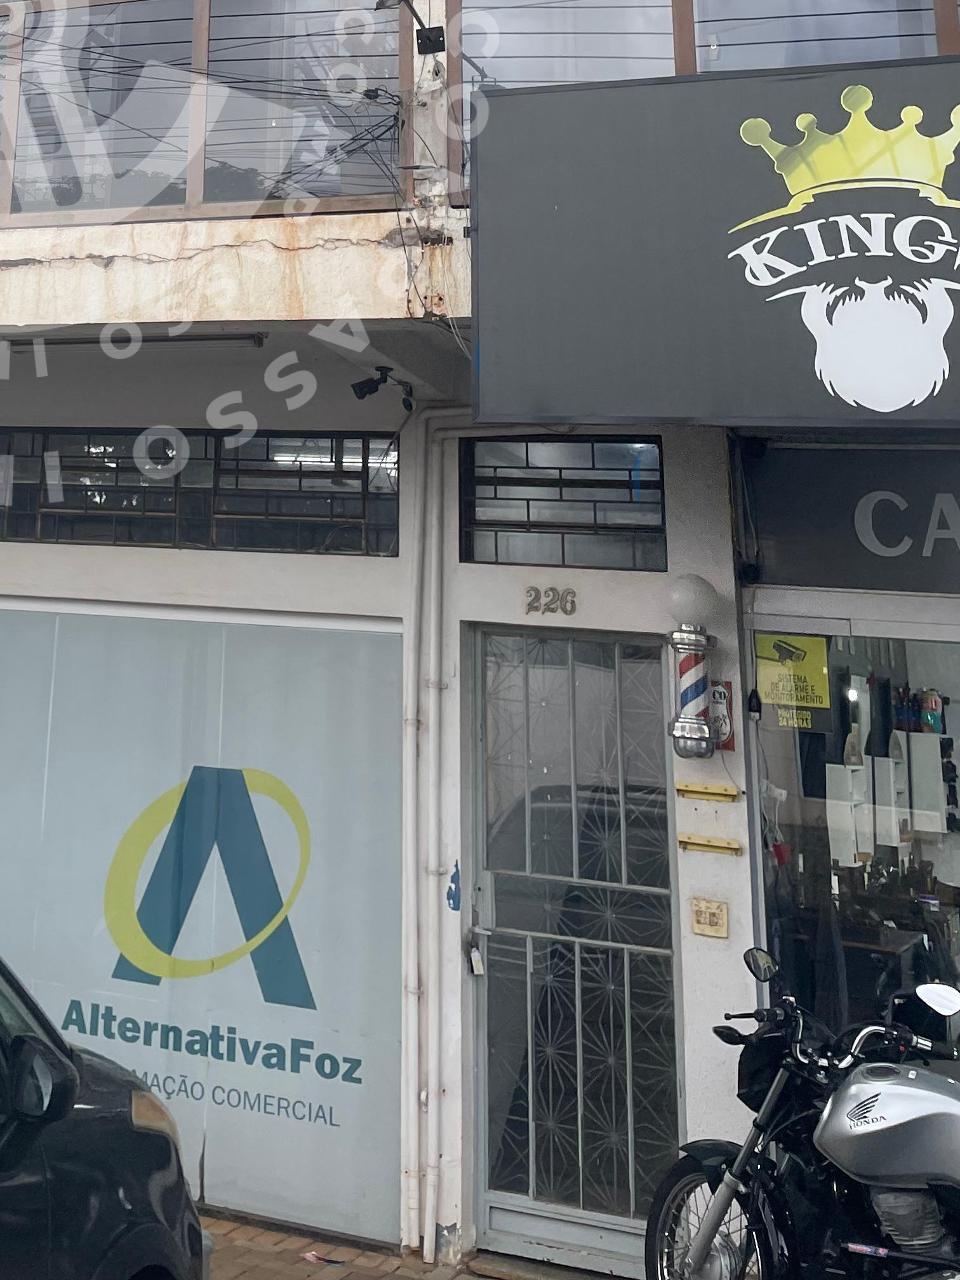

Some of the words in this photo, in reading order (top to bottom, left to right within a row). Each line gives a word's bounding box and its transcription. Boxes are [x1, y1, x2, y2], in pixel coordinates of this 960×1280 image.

[728, 213, 960, 287] KING
[526, 586, 576, 616] 226
[778, 673, 808, 684] SISTEMA
[771, 682, 779, 691] DE
[781, 683, 809, 693] ALARME
[810, 685, 815, 694] E
[764, 691, 823, 704] MONITORAMENTO
[778, 708, 811, 718] PROTEGIDO
[779, 717, 787, 726] 24
[788, 718, 812, 728] HORAS
[61, 999, 363, 1085] AlternativaFoz
[212, 1085, 341, 1128] COMERCIAL
[848, 1115, 887, 1130] HONDA
